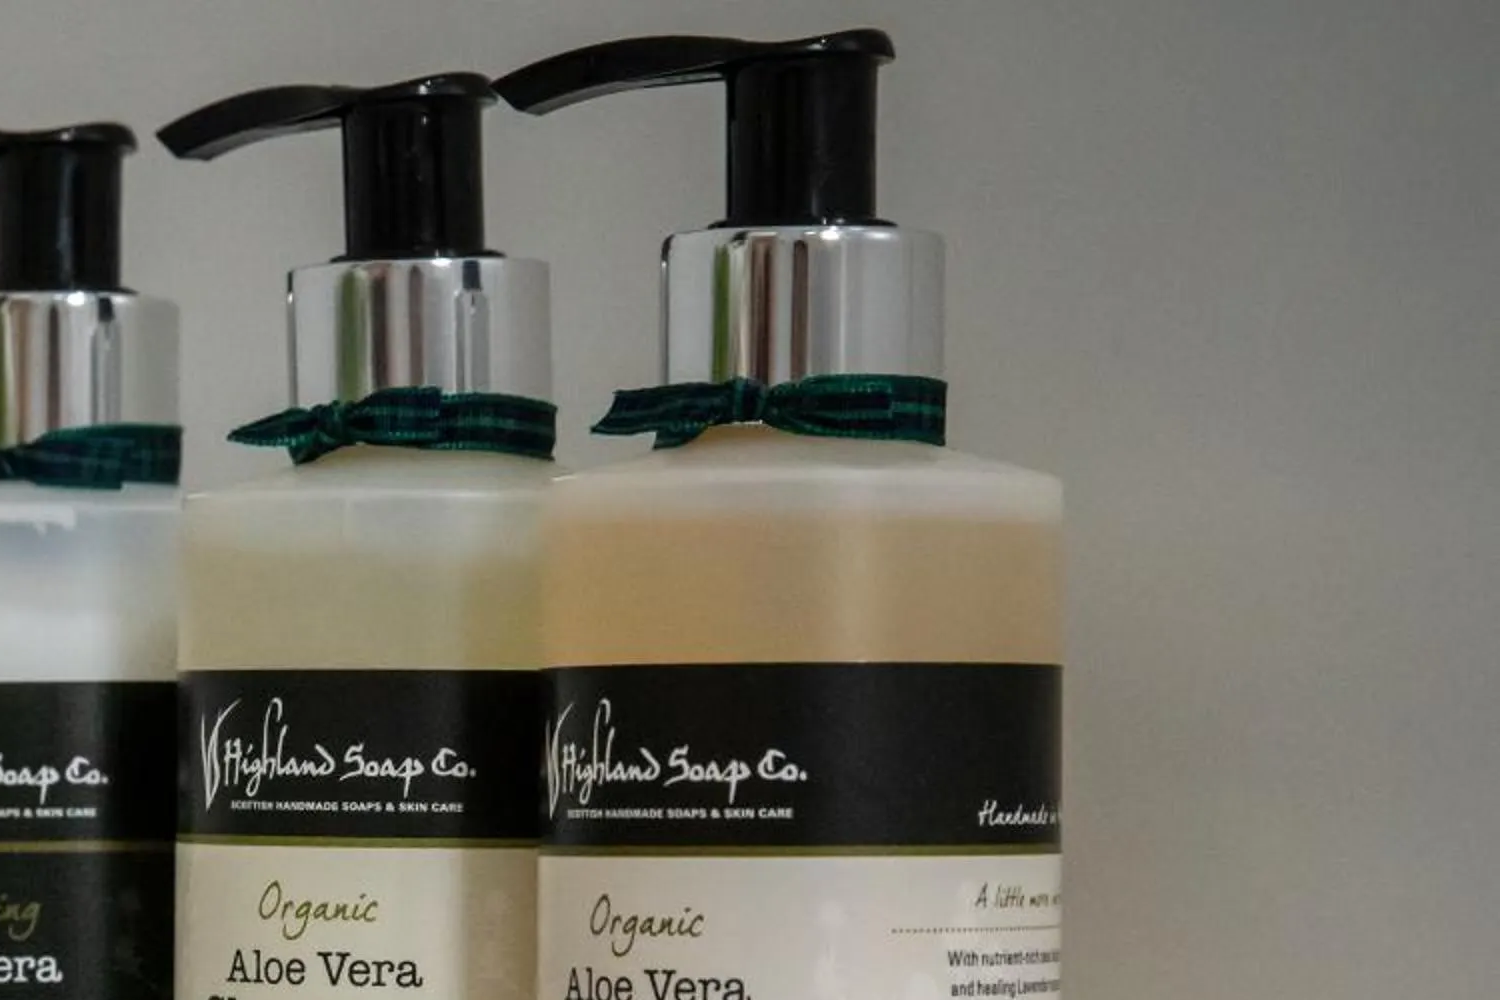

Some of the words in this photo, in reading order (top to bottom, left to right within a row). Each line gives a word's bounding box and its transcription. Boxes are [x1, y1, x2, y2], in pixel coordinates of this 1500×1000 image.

[224, 698, 336, 796] Highland
[340, 743, 424, 797] Soap
[431, 748, 477, 778] Co.
[562, 698, 661, 805] Highland
[663, 744, 751, 804] Soap
[757, 750, 807, 781] Co.
[65, 756, 109, 785] Co.
[23, 808, 32, 817] &
[36, 807, 63, 817] SKIN
[66, 807, 97, 817] CARE
[276, 801, 339, 812] HANDMADE
[341, 802, 382, 812] SOAPS
[385, 802, 395, 812] &
[398, 802, 428, 812] SKIN
[431, 802, 463, 813] CARE
[605, 809, 664, 819] HANDMADE
[667, 809, 707, 819] SOAPS
[710, 809, 721, 819] &
[724, 809, 755, 819] SKIN
[758, 808, 794, 819] CARE
[258, 880, 378, 940] Organic
[589, 893, 705, 957] Organic
[226, 949, 306, 985] Aloe
[317, 951, 424, 988] Vera
[947, 950, 978, 967] With
[951, 980, 974, 997] and
[977, 979, 1016, 998] healing
